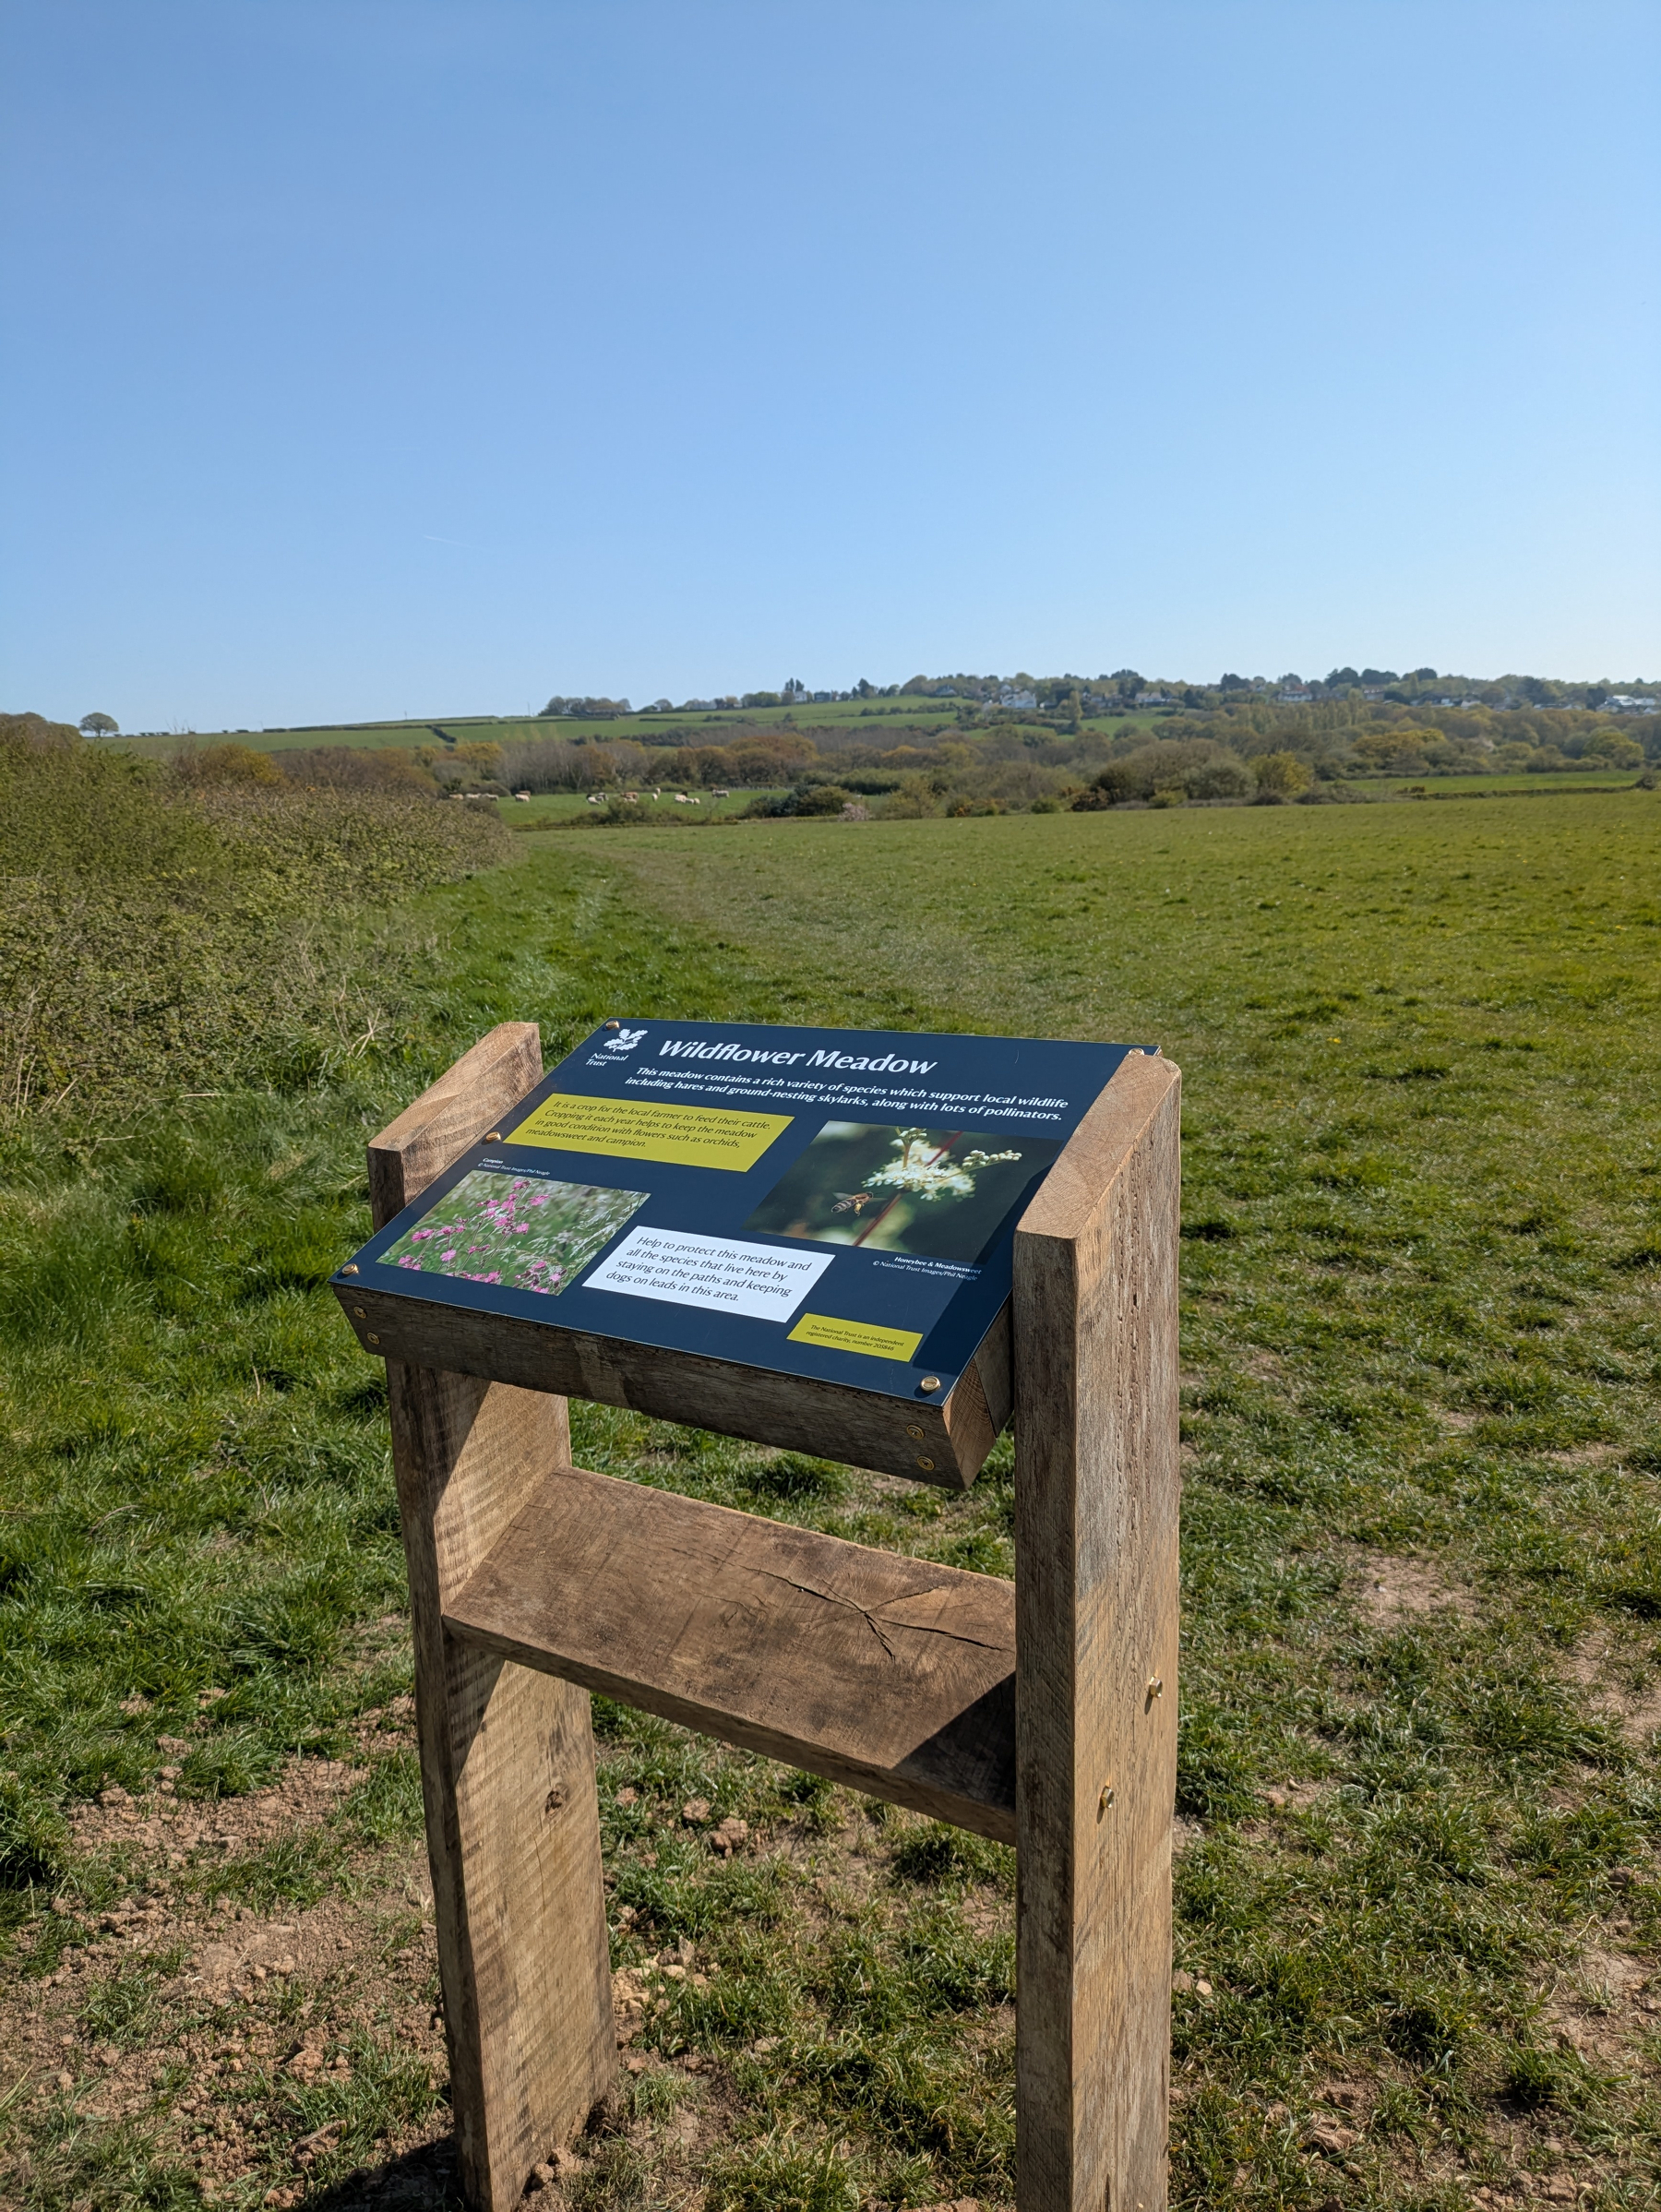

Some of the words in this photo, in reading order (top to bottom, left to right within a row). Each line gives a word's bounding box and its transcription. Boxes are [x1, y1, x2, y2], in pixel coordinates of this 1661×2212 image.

[659, 1041, 806, 1065] Wildflower
[806, 1050, 938, 1074] Meadow
[625, 1077, 675, 1090] including
[675, 1082, 704, 1091] hares
[705, 1084, 728, 1093] and
[726, 1086, 817, 1103] ground-nesting
[818, 1094, 868, 1106] skylarks,
[872, 1098, 909, 1110] along
[910, 1102, 938, 1111] with
[940, 1104, 966, 1113] lots
[968, 1106, 984, 1115] of
[984, 1108, 1062, 1120] pollinators.
[637, 1068, 658, 1076] This
[659, 1070, 704, 1080] meadow
[705, 1073, 752, 1084] contains
[762, 1078, 784, 1086] rich
[786, 1081, 825, 1091] variety
[842, 1085, 888, 1094] species
[890, 1088, 926, 1097] which
[928, 1093, 981, 1102] support
[983, 1094, 1017, 1104] local
[1019, 1097, 1069, 1108] wildlife
[544, 1119, 569, 1128] good
[568, 1123, 611, 1132] condition
[633, 1129, 669, 1139] flowers
[667, 1133, 689, 1142] such
[703, 1138, 740, 1148] orchids,
[545, 1110, 584, 1120] Cropping
[593, 1116, 615, 1124] each
[636, 1119, 660, 1128] helps
[673, 1123, 697, 1132] keep
[714, 1129, 758, 1138] meadow
[628, 1108, 651, 1117] local
[651, 1110, 682, 1119] farmer
[695, 1115, 718, 1123] feed
[719, 1118, 741, 1126] their
[741, 1120, 771, 1130] cattle.
[526, 1128, 586, 1141] meadowsweet
[587, 1133, 605, 1142] and
[605, 1137, 646, 1147] campion.
[627, 1249, 642, 1257] all
[642, 1250, 659, 1261] the
[659, 1255, 698, 1266] species
[699, 1261, 722, 1271] that
[723, 1263, 745, 1273] live
[744, 1267, 771, 1277] here
[773, 1273, 788, 1282] by
[637, 1237, 662, 1249] Help
[663, 1241, 675, 1249] to
[675, 1243, 716, 1256] protect
[717, 1250, 738, 1260] this
[739, 1255, 787, 1267] meadow
[787, 1261, 812, 1271] and
[894, 1257, 927, 1266] Honeybee
[935, 1263, 982, 1273] Meadowsweet
[616, 1261, 656, 1274] staying
[655, 1266, 669, 1274] on
[671, 1267, 690, 1278] the
[689, 1273, 723, 1284] paths
[723, 1278, 747, 1288] and
[746, 1281, 793, 1297] keeping
[880, 1261, 904, 1270] National
[921, 1268, 956, 1277] Images/Phil
[606, 1272, 632, 1284] dogs
[633, 1276, 648, 1285] on
[649, 1278, 677, 1290] leads
[678, 1283, 689, 1292] in
[691, 1286, 712, 1297] this
[713, 1292, 739, 1301] area.
[807, 1331, 832, 1339] registered
[832, 1334, 851, 1343] charity,
[870, 1336, 904, 1346] independent
